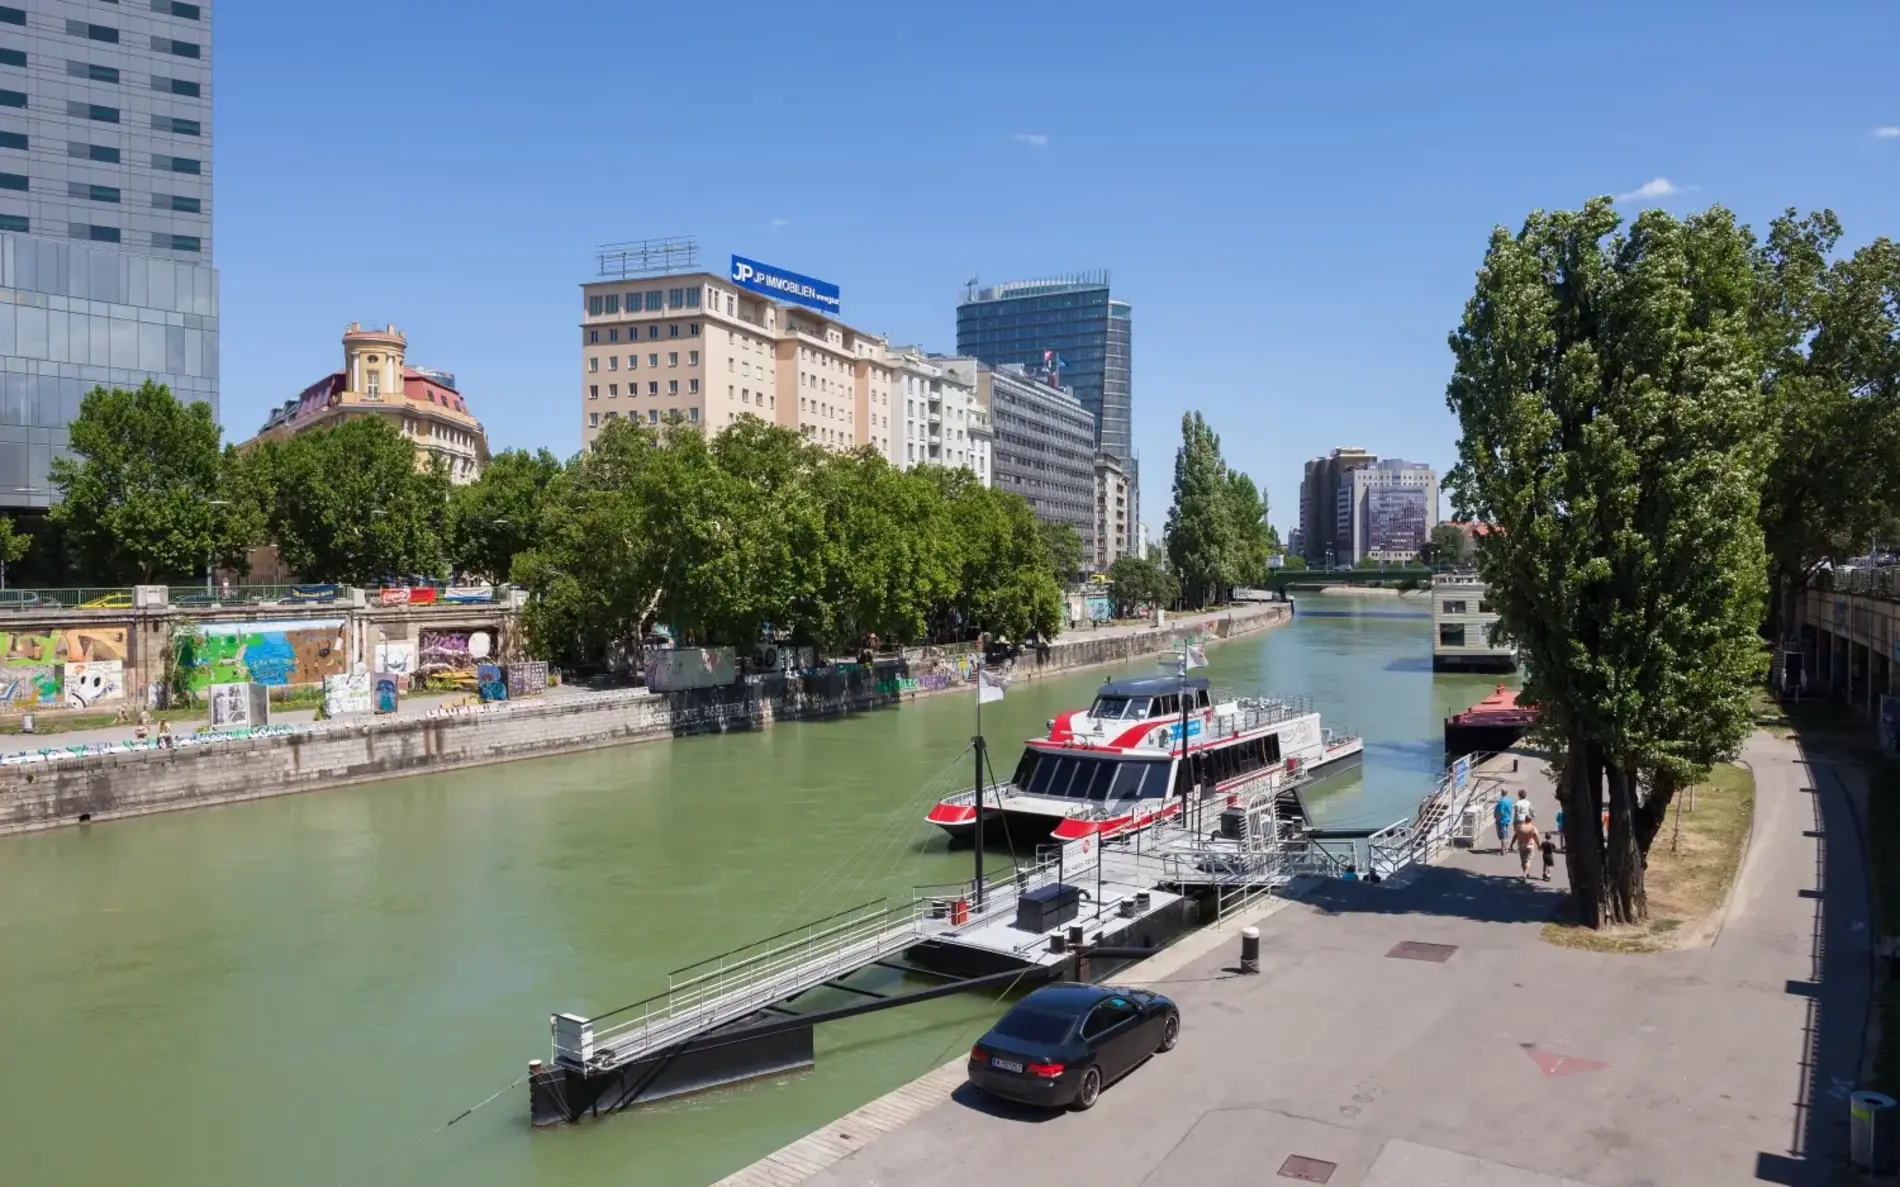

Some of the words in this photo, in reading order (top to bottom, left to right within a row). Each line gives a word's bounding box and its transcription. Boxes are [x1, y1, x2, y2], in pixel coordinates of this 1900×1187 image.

[732, 262, 753, 282] JP
[753, 271, 765, 283] JP
[765, 275, 815, 298] IMMOBILIEN
